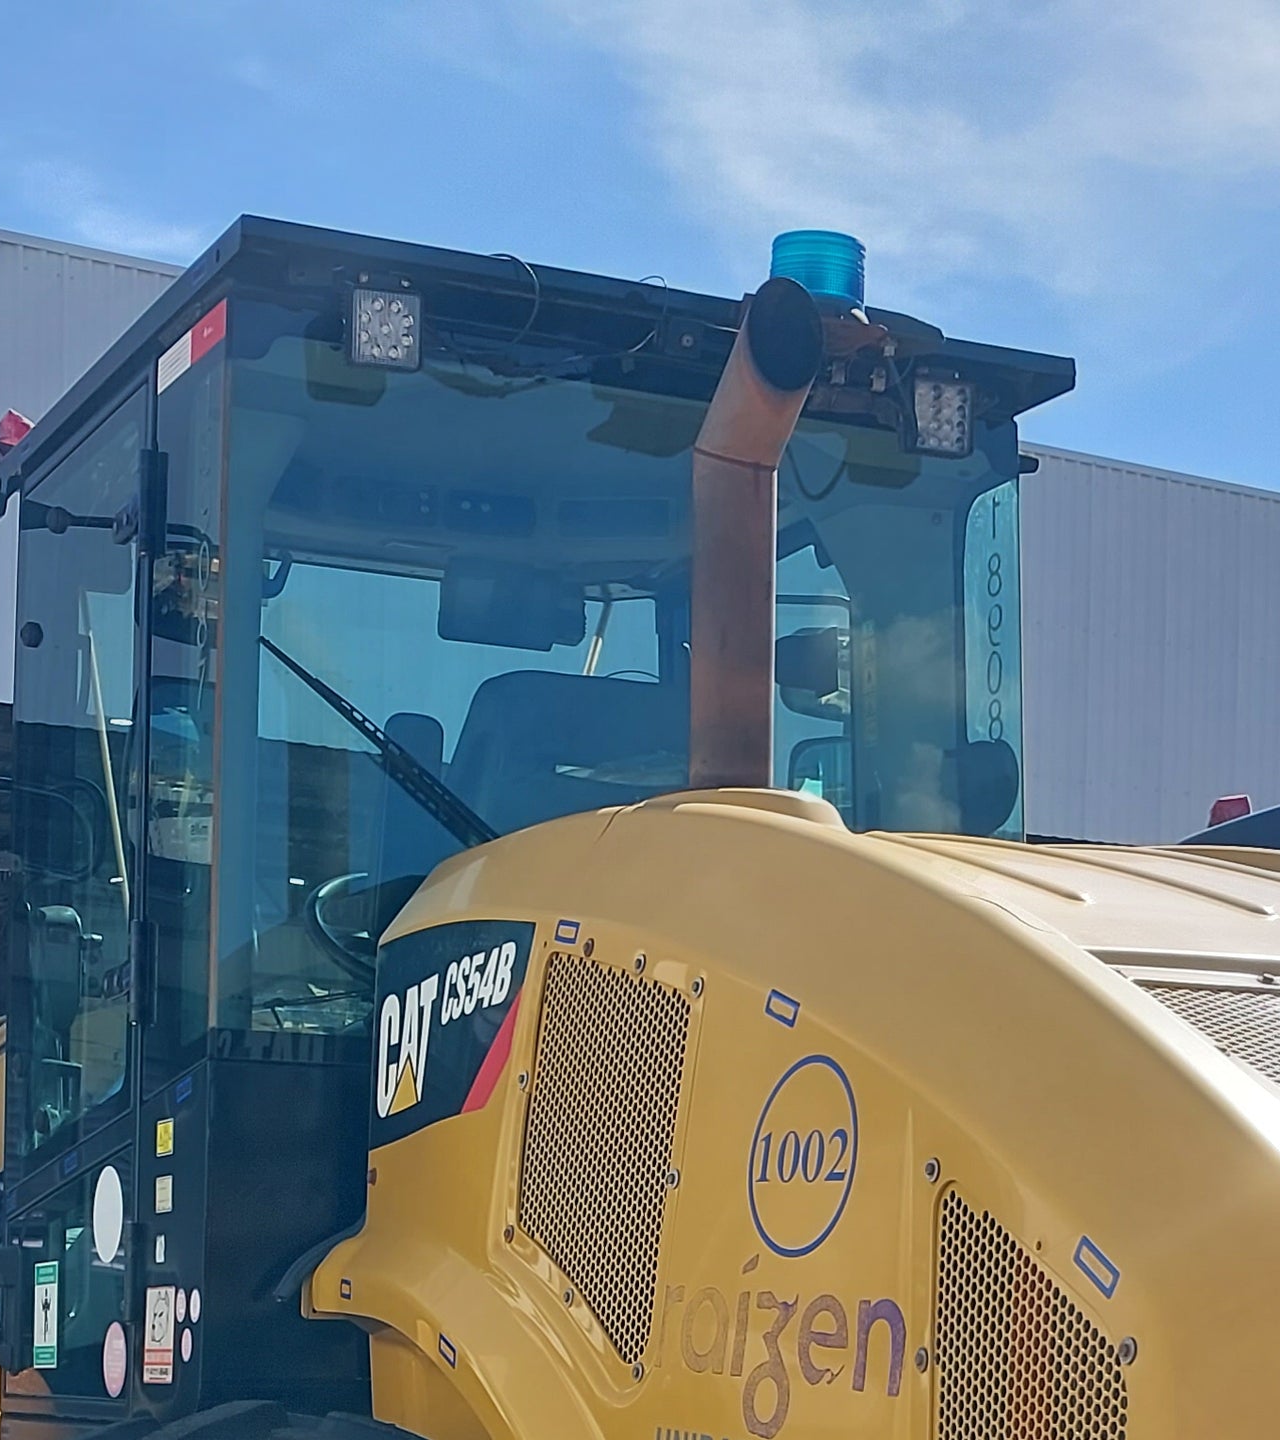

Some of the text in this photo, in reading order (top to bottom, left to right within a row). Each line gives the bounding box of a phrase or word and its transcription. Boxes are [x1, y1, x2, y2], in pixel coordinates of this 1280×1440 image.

[376, 940, 517, 1119] CAT CS54B
[755, 1127, 849, 1184] 1002
